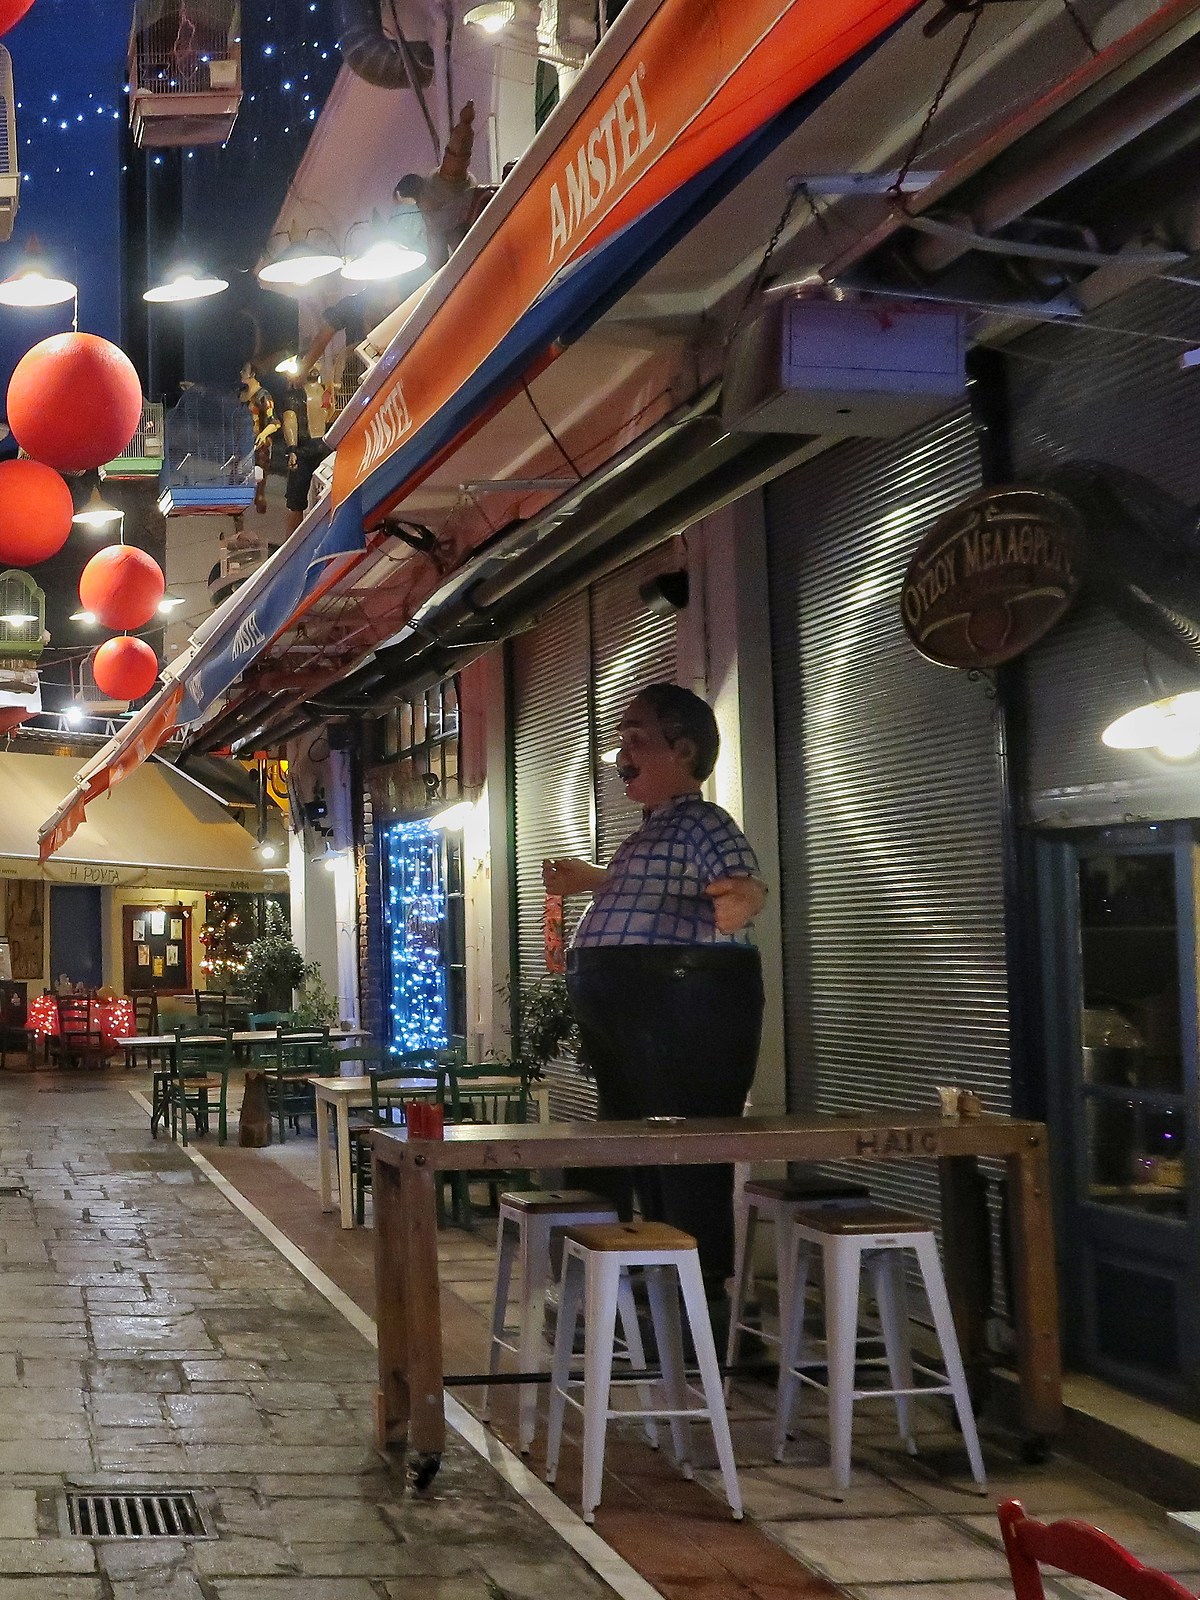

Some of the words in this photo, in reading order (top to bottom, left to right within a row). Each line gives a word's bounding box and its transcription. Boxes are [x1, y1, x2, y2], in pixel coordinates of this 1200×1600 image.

[548, 68, 657, 264] AMSTEL
[355, 381, 412, 478] AMSTEL
[84, 867, 120, 883] ΡΟΥΓΑ
